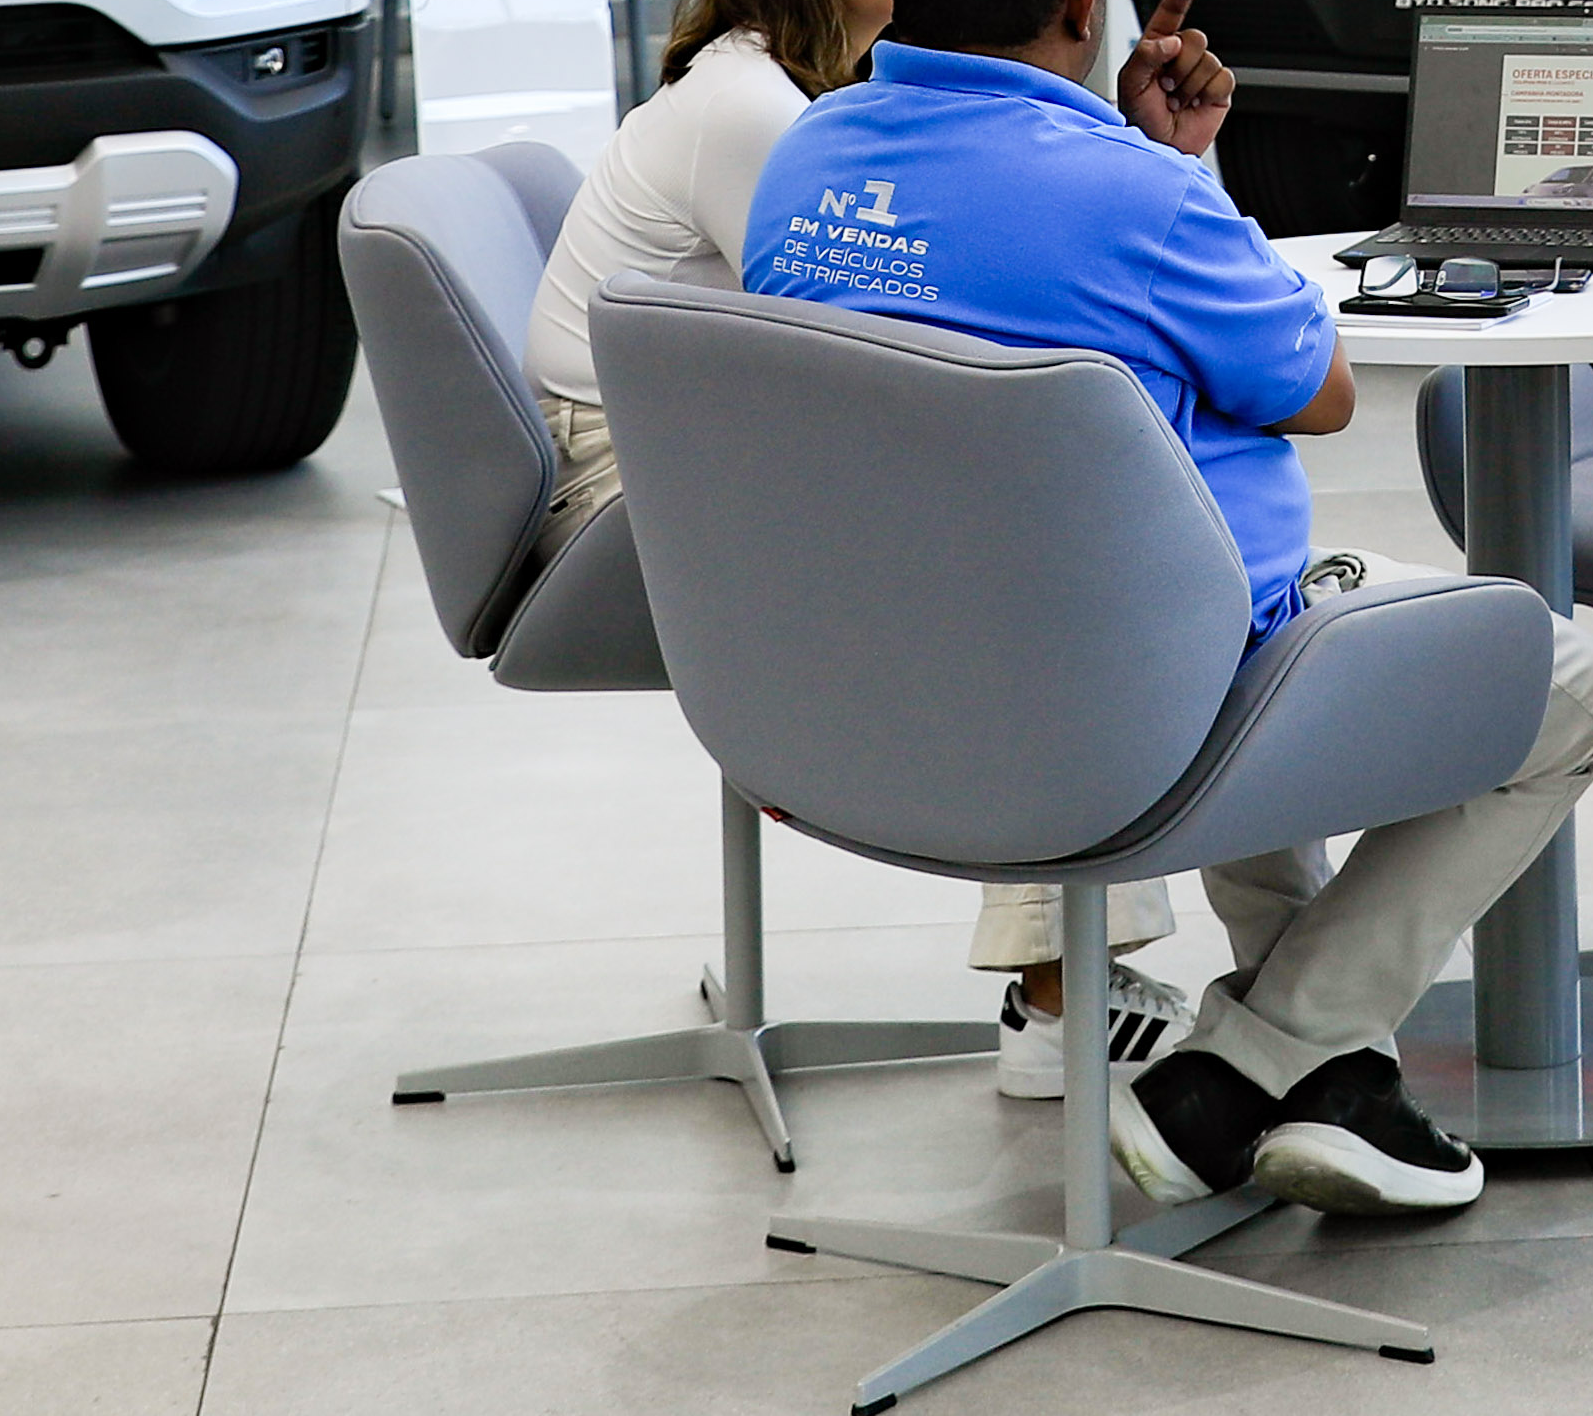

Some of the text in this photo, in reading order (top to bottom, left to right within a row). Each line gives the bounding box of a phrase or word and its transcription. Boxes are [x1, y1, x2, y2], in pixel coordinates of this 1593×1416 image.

[1512, 69, 1553, 79] OFERTA
[789, 216, 930, 255] EM VENDAS
[773, 256, 940, 301] ELETRIFICADOS
[784, 239, 925, 279] DE VEÍCULOS
